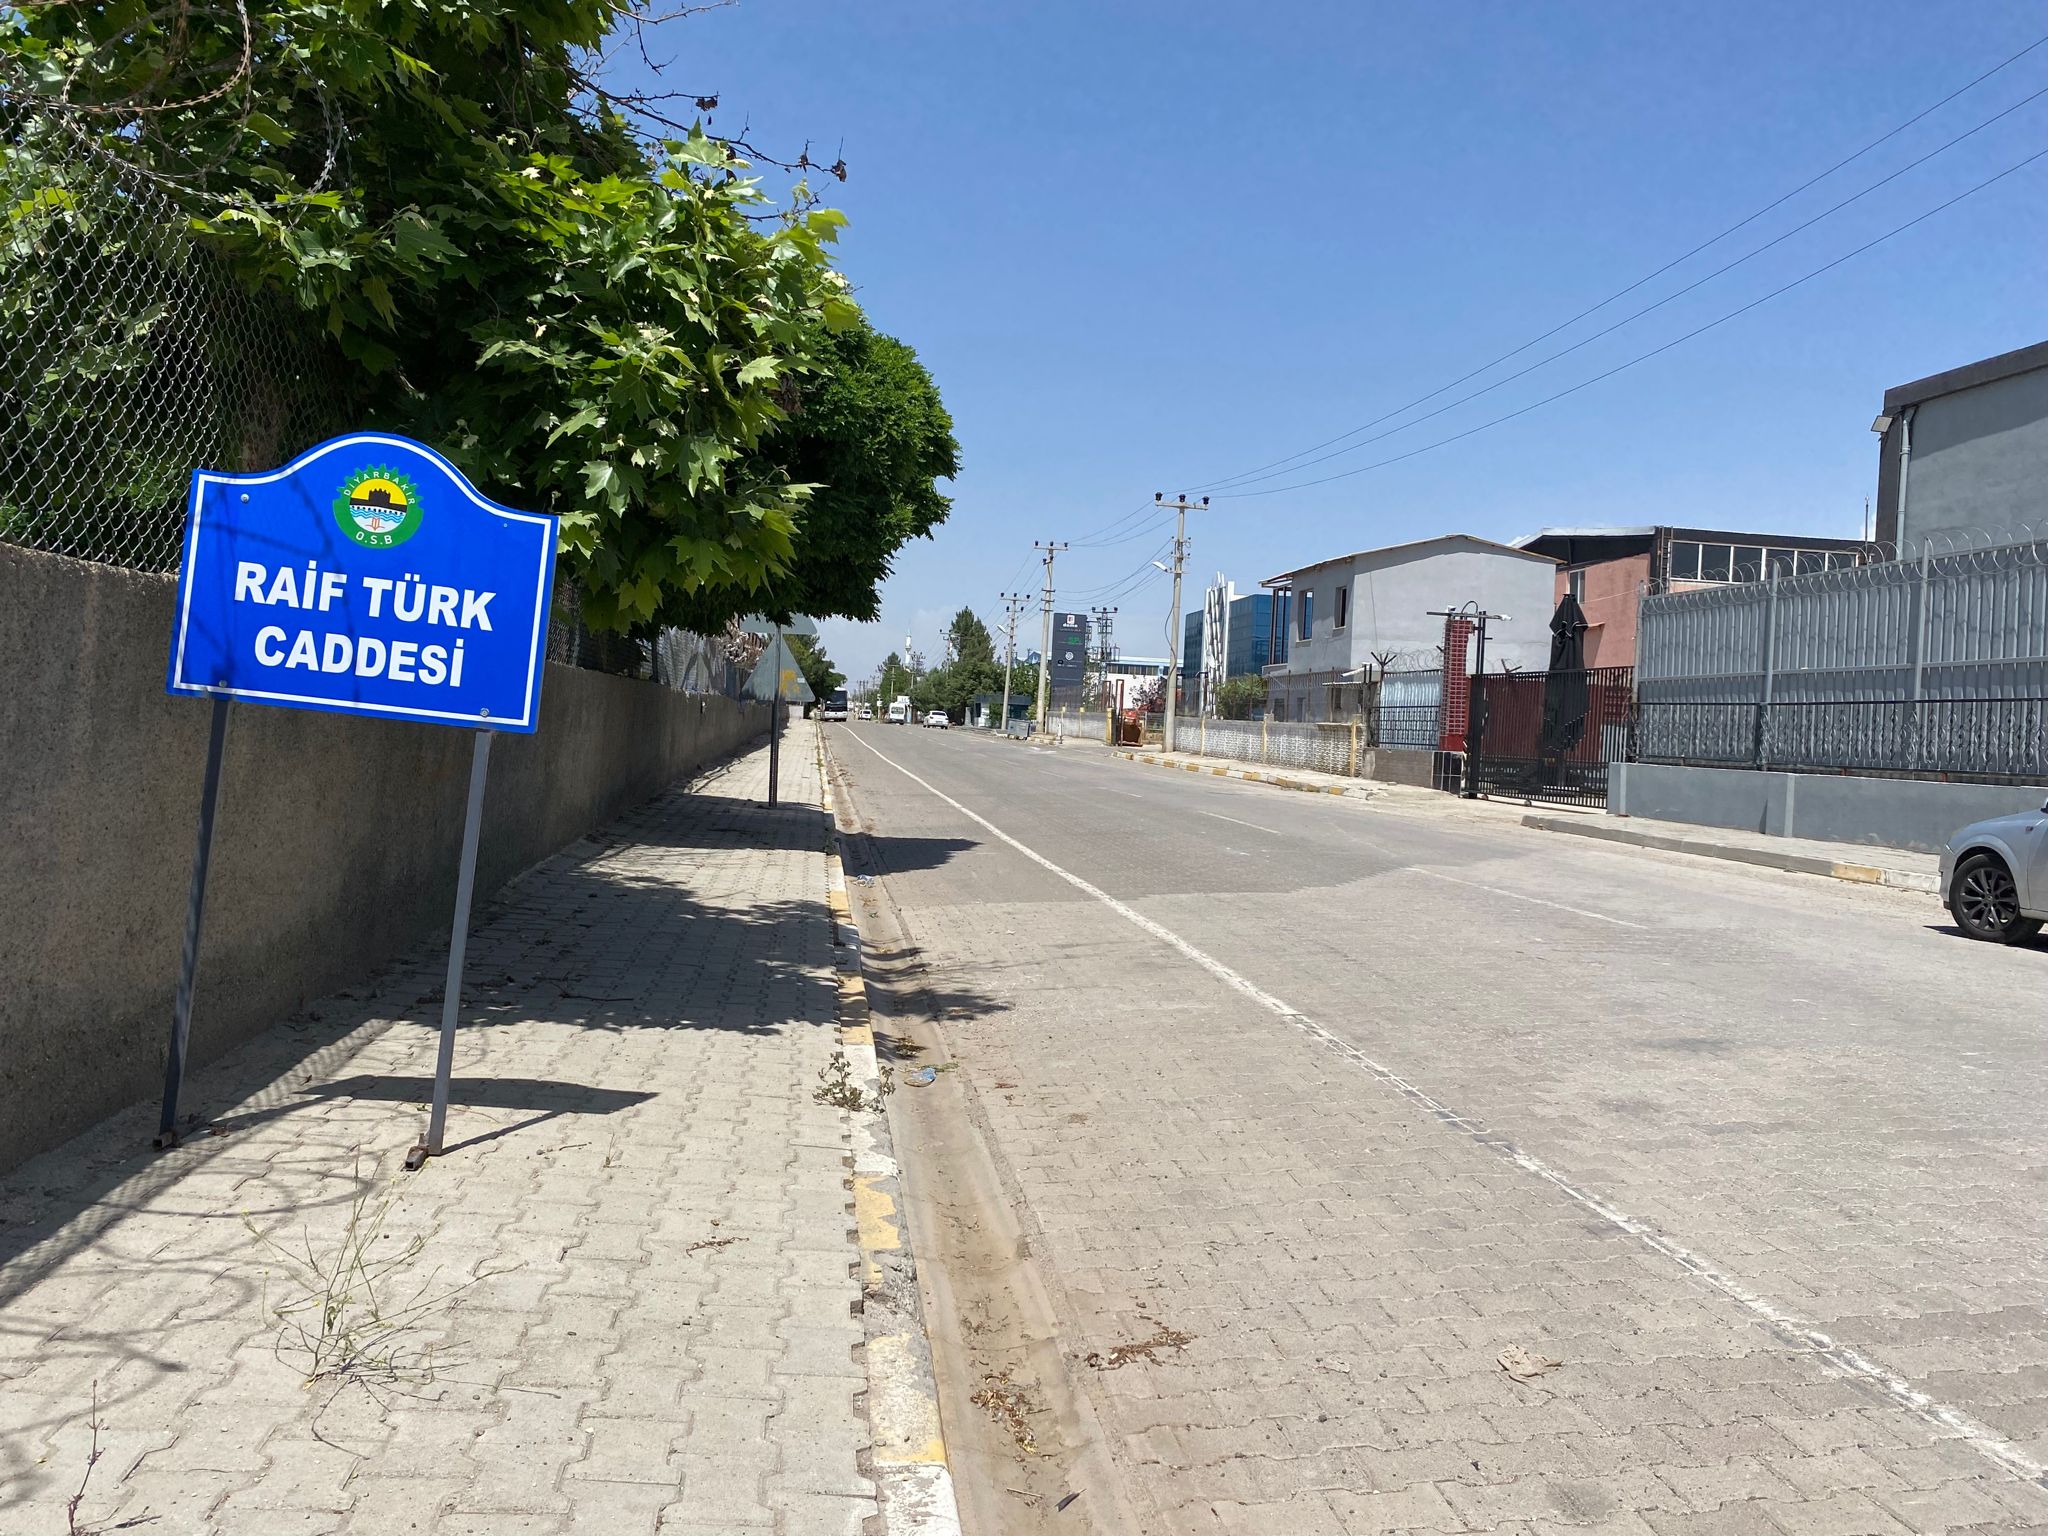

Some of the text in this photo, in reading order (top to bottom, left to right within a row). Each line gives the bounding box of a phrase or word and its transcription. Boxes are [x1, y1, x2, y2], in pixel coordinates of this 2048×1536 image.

[234, 560, 496, 631] RAİF TÜRK
[254, 626, 465, 687] CADDESİ
